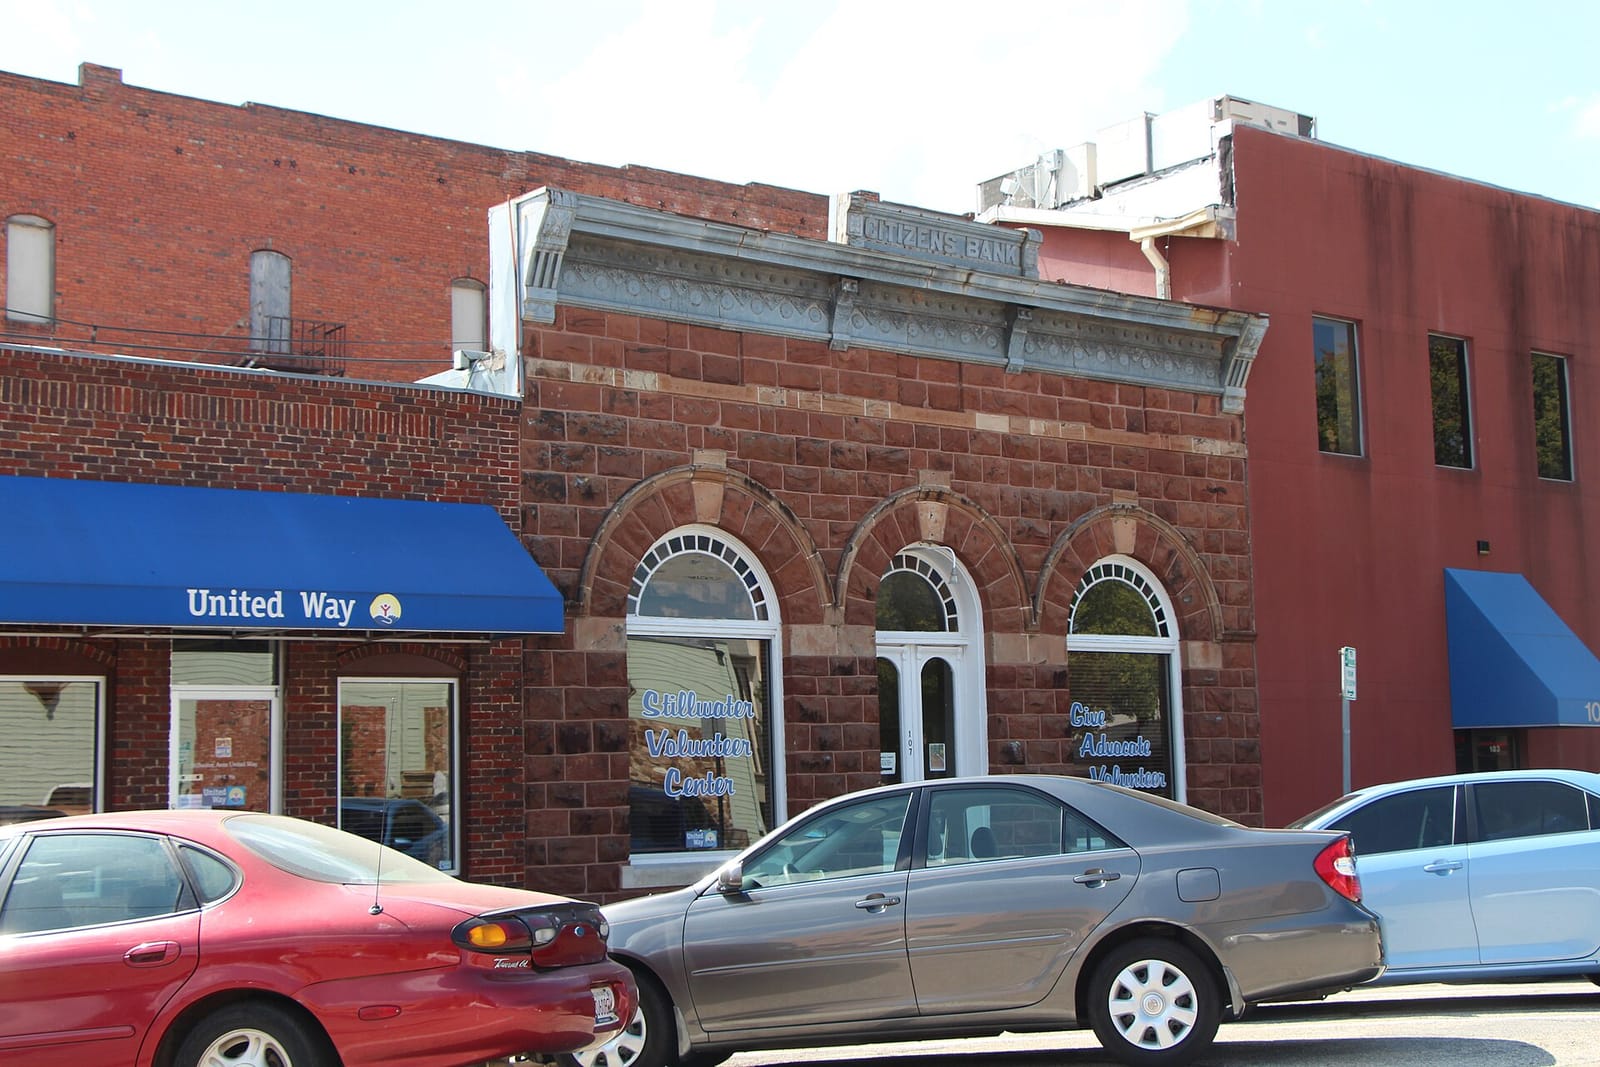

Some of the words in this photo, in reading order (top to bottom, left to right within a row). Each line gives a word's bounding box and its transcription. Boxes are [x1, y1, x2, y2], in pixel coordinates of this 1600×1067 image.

[864, 216, 958, 251] CITIZENS
[964, 236, 1017, 265] BANK
[187, 588, 284, 618] United
[300, 591, 356, 627] Way
[642, 689, 755, 719] Stillwater
[1070, 701, 1106, 727] Give
[645, 728, 752, 758] Volunteer
[1079, 732, 1152, 758] Advocate
[664, 767, 736, 798] Center
[1089, 765, 1167, 788] Volunteer
[203, 788, 226, 797] United
[212, 796, 226, 806] Way
